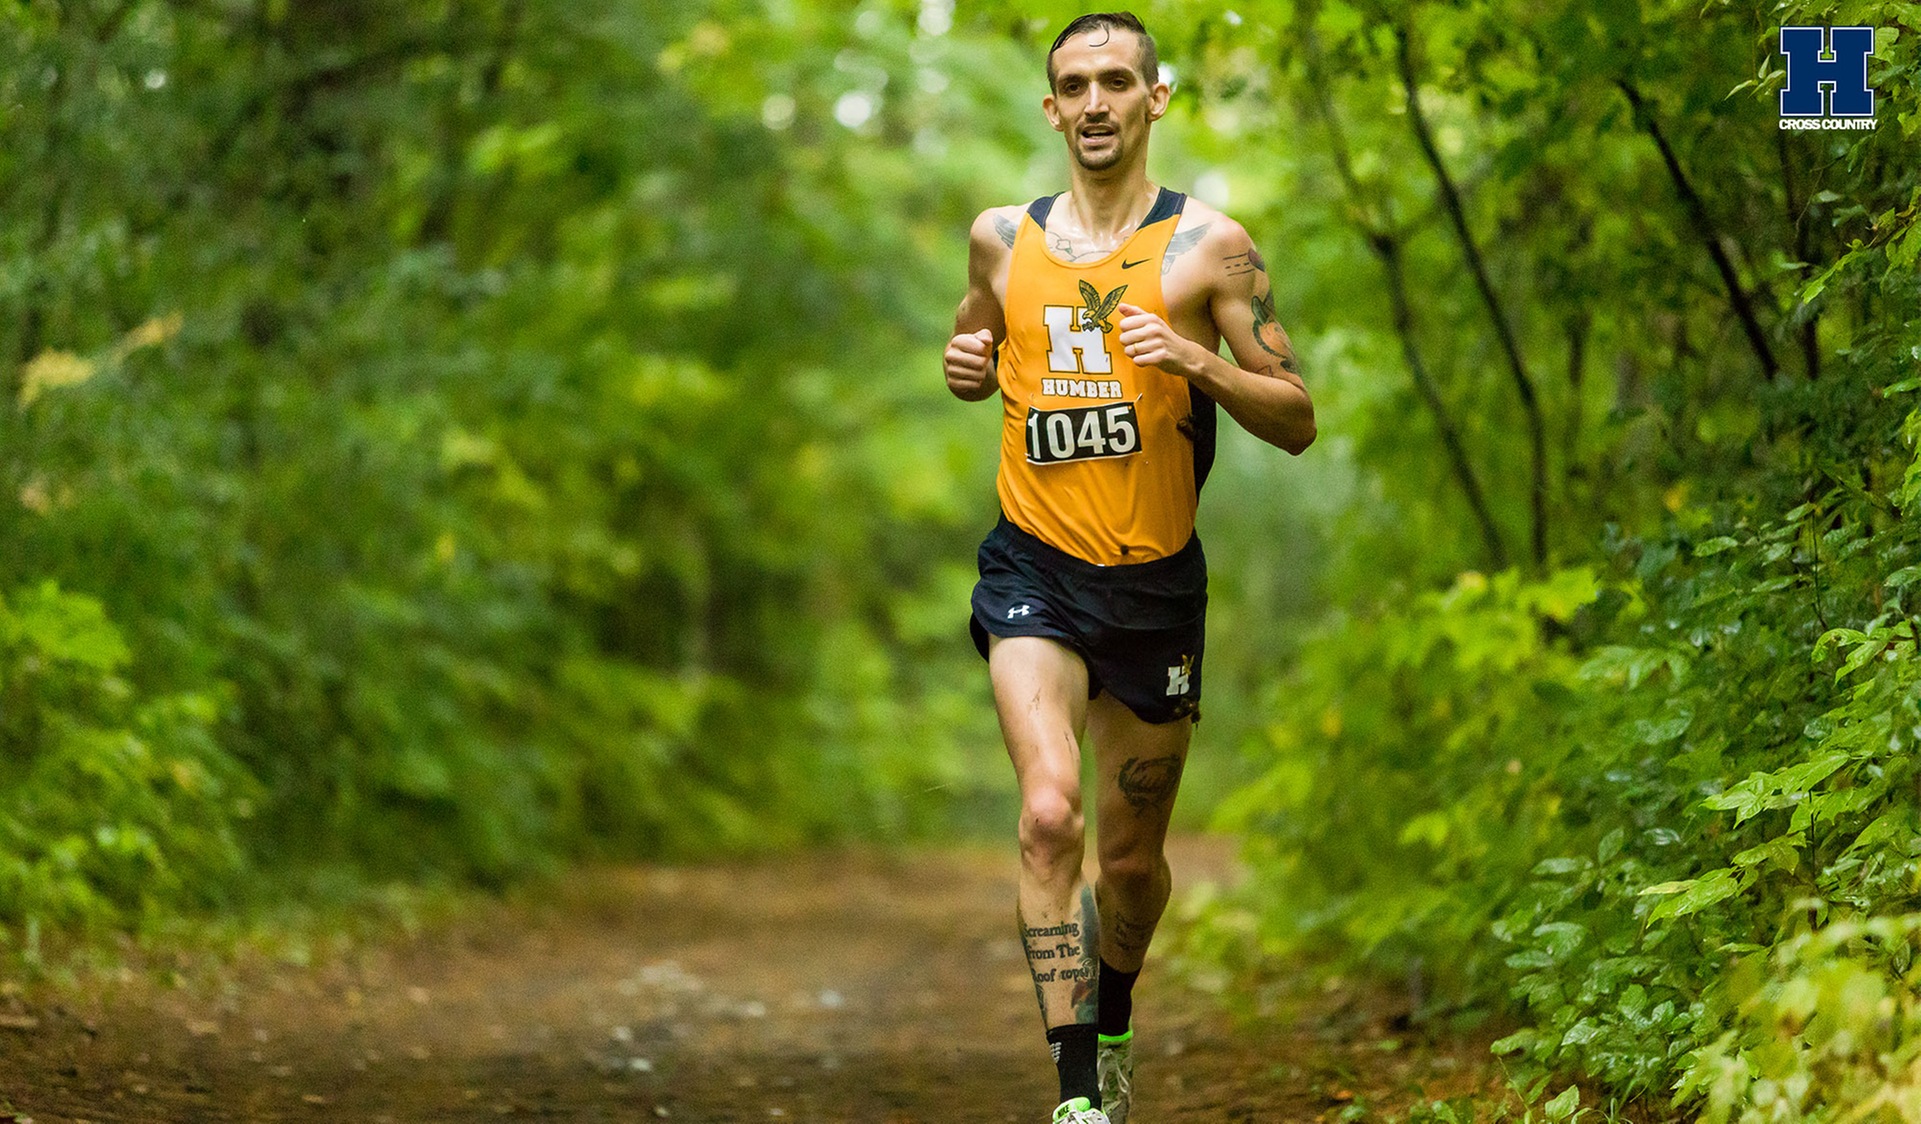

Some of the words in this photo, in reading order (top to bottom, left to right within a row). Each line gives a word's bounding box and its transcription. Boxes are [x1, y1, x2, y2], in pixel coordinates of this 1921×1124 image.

[1043, 305, 1113, 374] H
[1041, 378, 1123, 399] HUMBER
[1027, 406, 1136, 460] 1045
[1056, 943, 1080, 958] The
